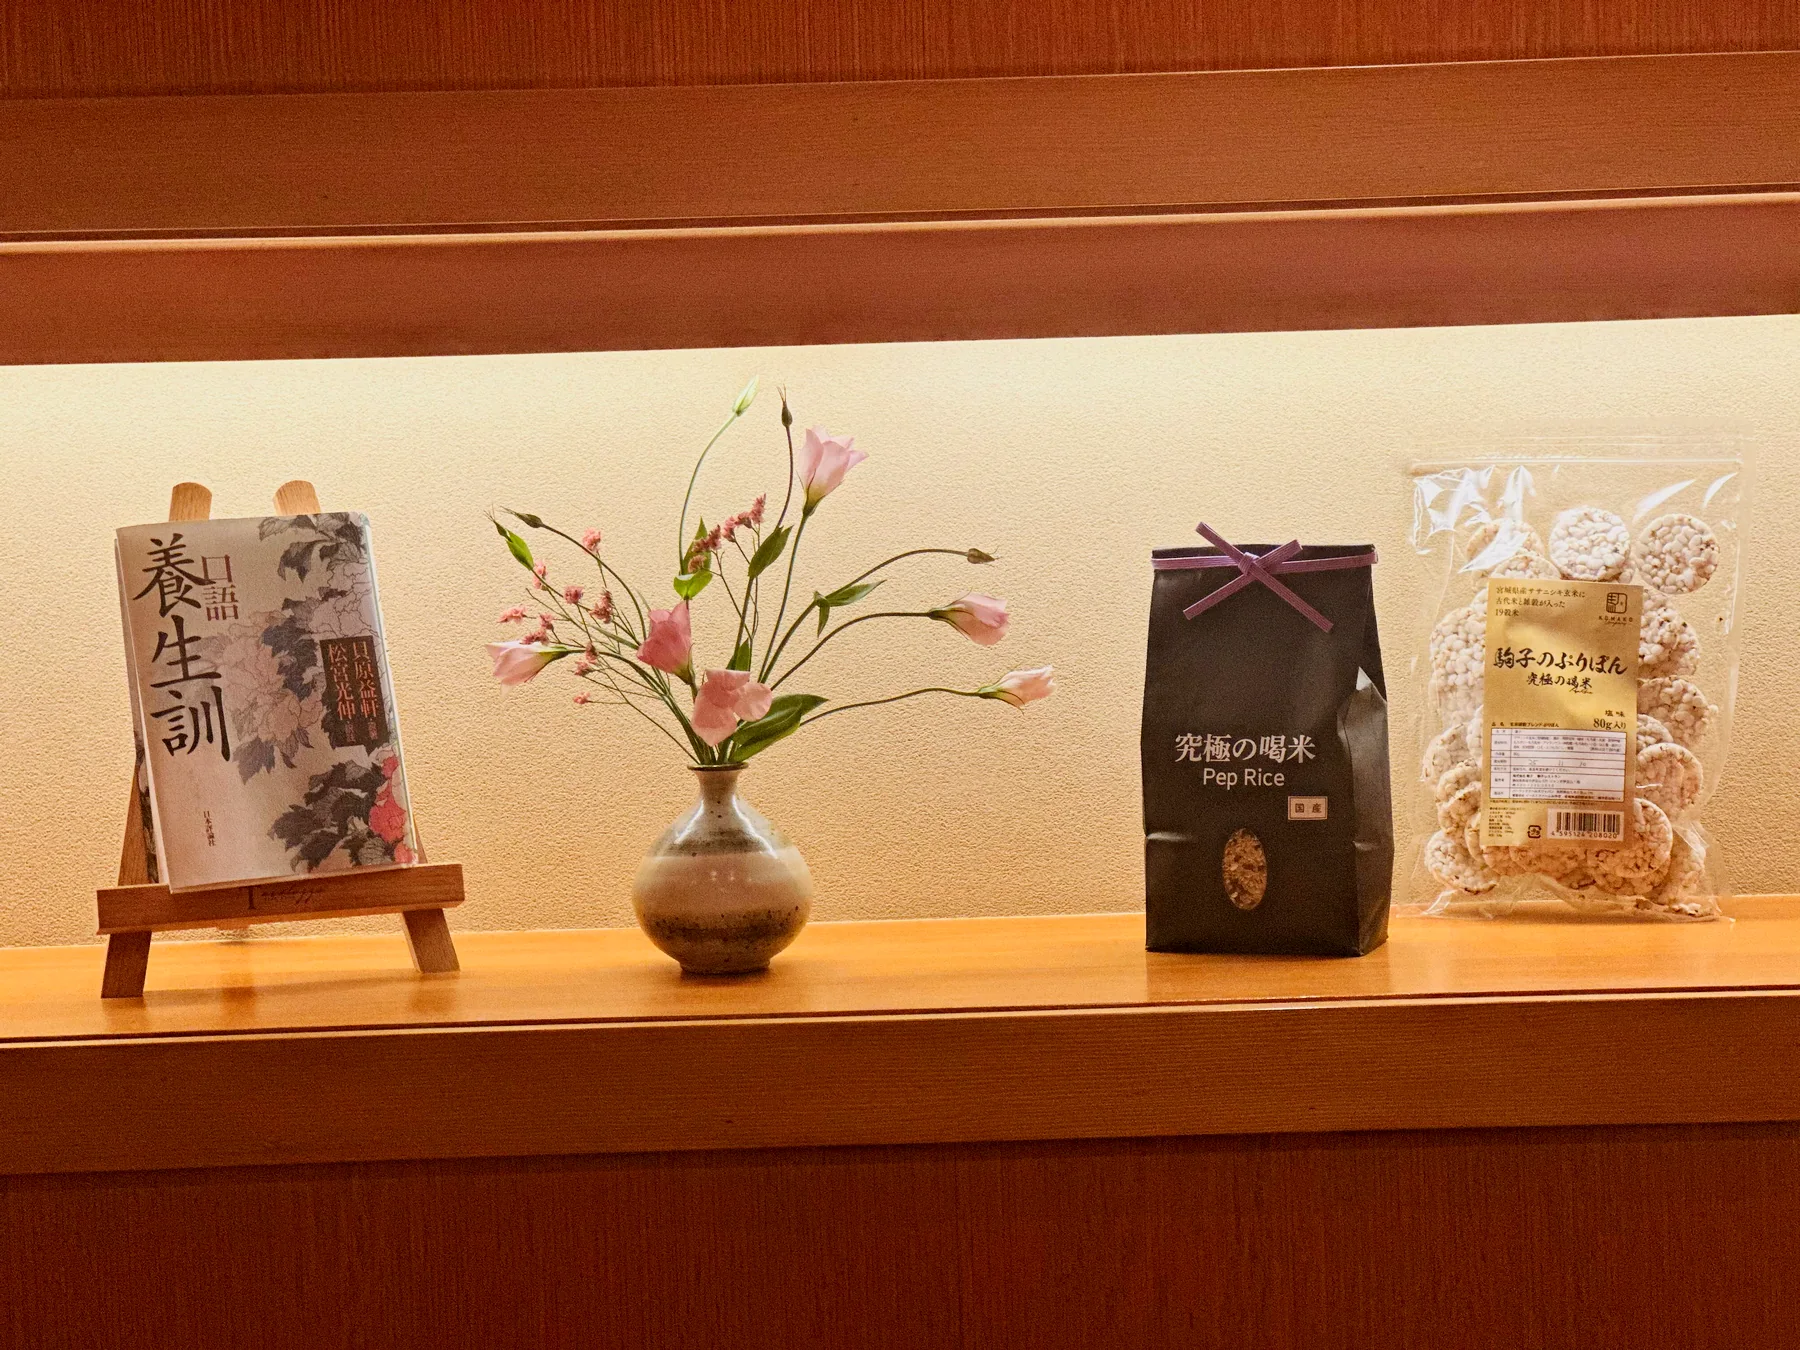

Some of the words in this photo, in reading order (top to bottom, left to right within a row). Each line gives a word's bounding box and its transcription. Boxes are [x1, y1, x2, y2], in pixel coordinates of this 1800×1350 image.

[201, 554, 239, 621] 口語
[1495, 608, 1519, 617] 19穀米
[133, 533, 230, 762] 養生訓
[1493, 647, 1628, 675] 駒子のぷりぽん
[353, 641, 379, 718] 貝原益軒
[1174, 733, 1316, 764] 究極の喝米
[1203, 768, 1238, 790] Pep
[1244, 768, 1285, 787] Rice
[1294, 802, 1322, 814] 国産
